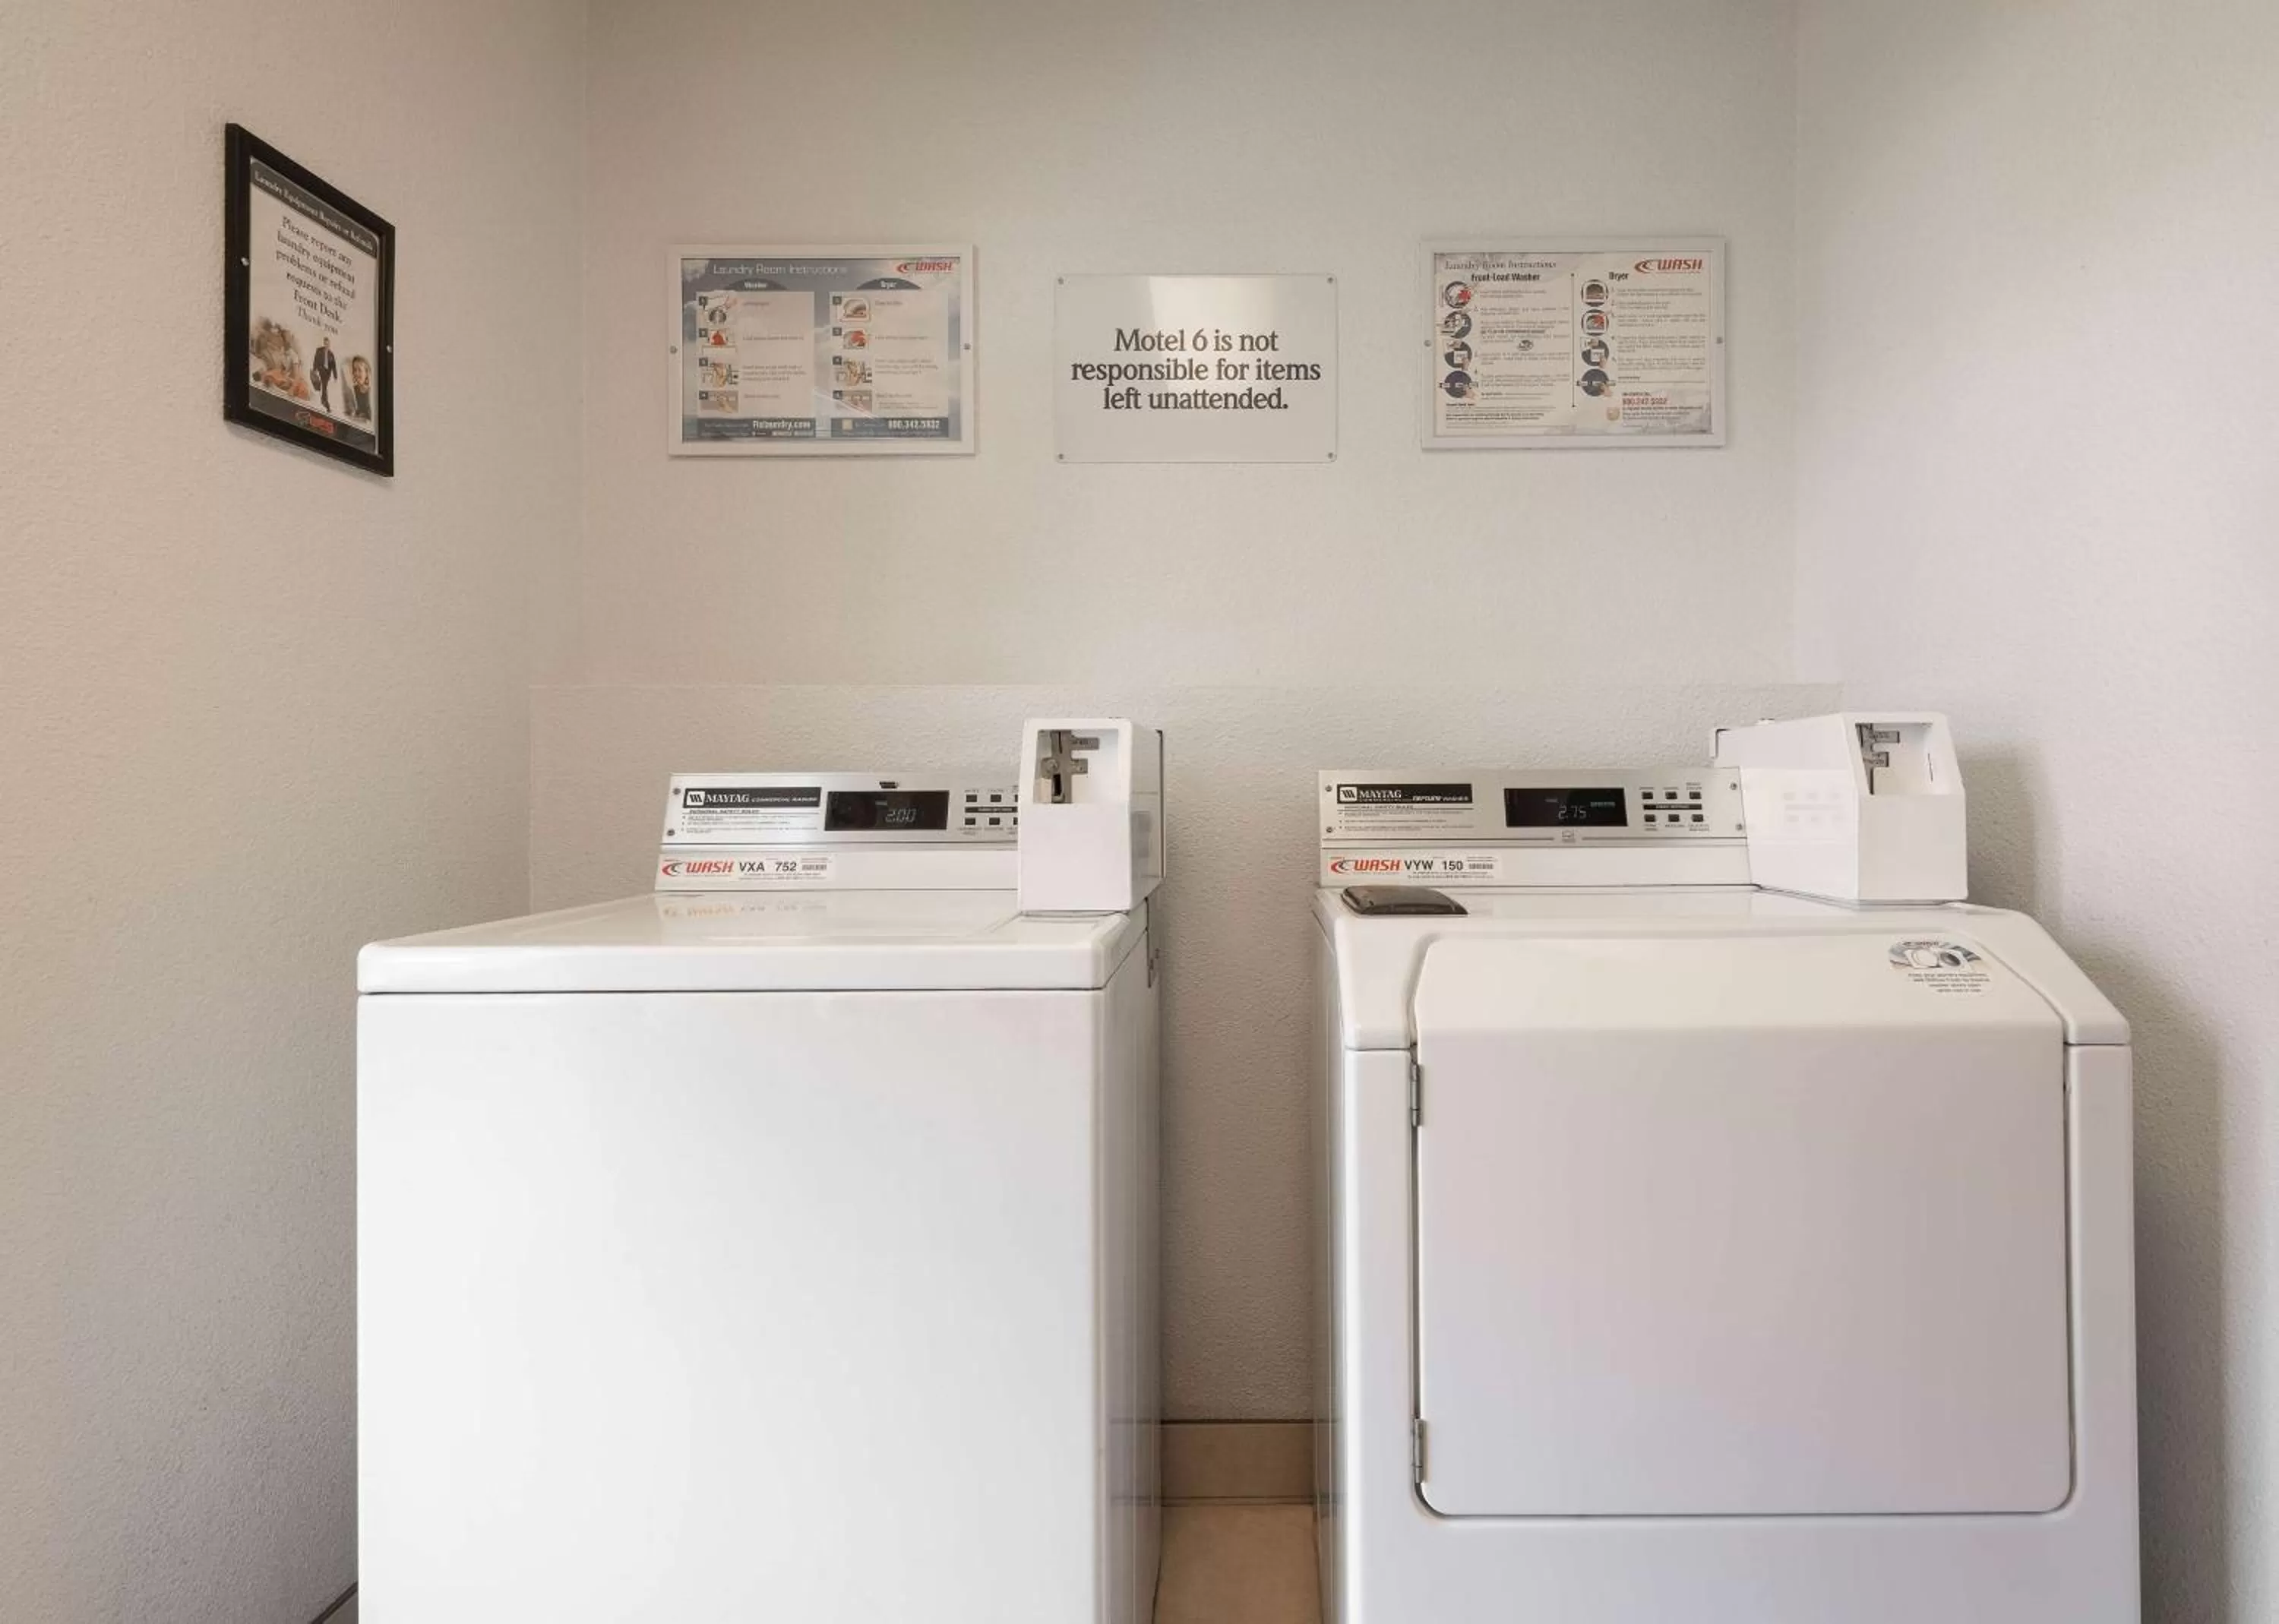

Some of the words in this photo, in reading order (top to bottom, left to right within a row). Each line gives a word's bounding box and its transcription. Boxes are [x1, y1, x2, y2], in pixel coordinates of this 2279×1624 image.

[283, 216, 309, 241] Please
[311, 235, 337, 257] report
[339, 253, 352, 267] any
[277, 230, 311, 261] laundry
[313, 254, 355, 285] equipment
[713, 264, 754, 276] Laundry
[756, 264, 786, 274] Room
[915, 261, 952, 271] WASH
[1444, 261, 1479, 270] Laundry
[1657, 259, 1702, 270] WASH
[276, 251, 317, 278] problems
[330, 280, 355, 299] refund
[1512, 273, 1541, 281] Washer
[1608, 272, 1629, 281] Dryer
[286, 272, 321, 295] requests
[881, 280, 897, 289] Dryer
[294, 289, 318, 311] Front
[1114, 328, 1186, 351] Motel
[1192, 328, 1209, 351] 6
[1213, 329, 1232, 351] is
[1238, 330, 1279, 351] not
[1071, 358, 1209, 385] responsible
[1215, 358, 1250, 380] for
[1256, 358, 1321, 380] items
[1103, 387, 1141, 409] left
[1147, 387, 1288, 409] unattended.
[706, 794, 750, 804] MAYTAG
[1358, 789, 1402, 798] MAYTAG
[686, 860, 735, 873] WASH
[739, 861, 765, 872] VXA
[775, 861, 797, 872] 752
[1354, 859, 1401, 871] WASH
[1405, 860, 1434, 870] VYW
[1442, 861, 1464, 871] 150
